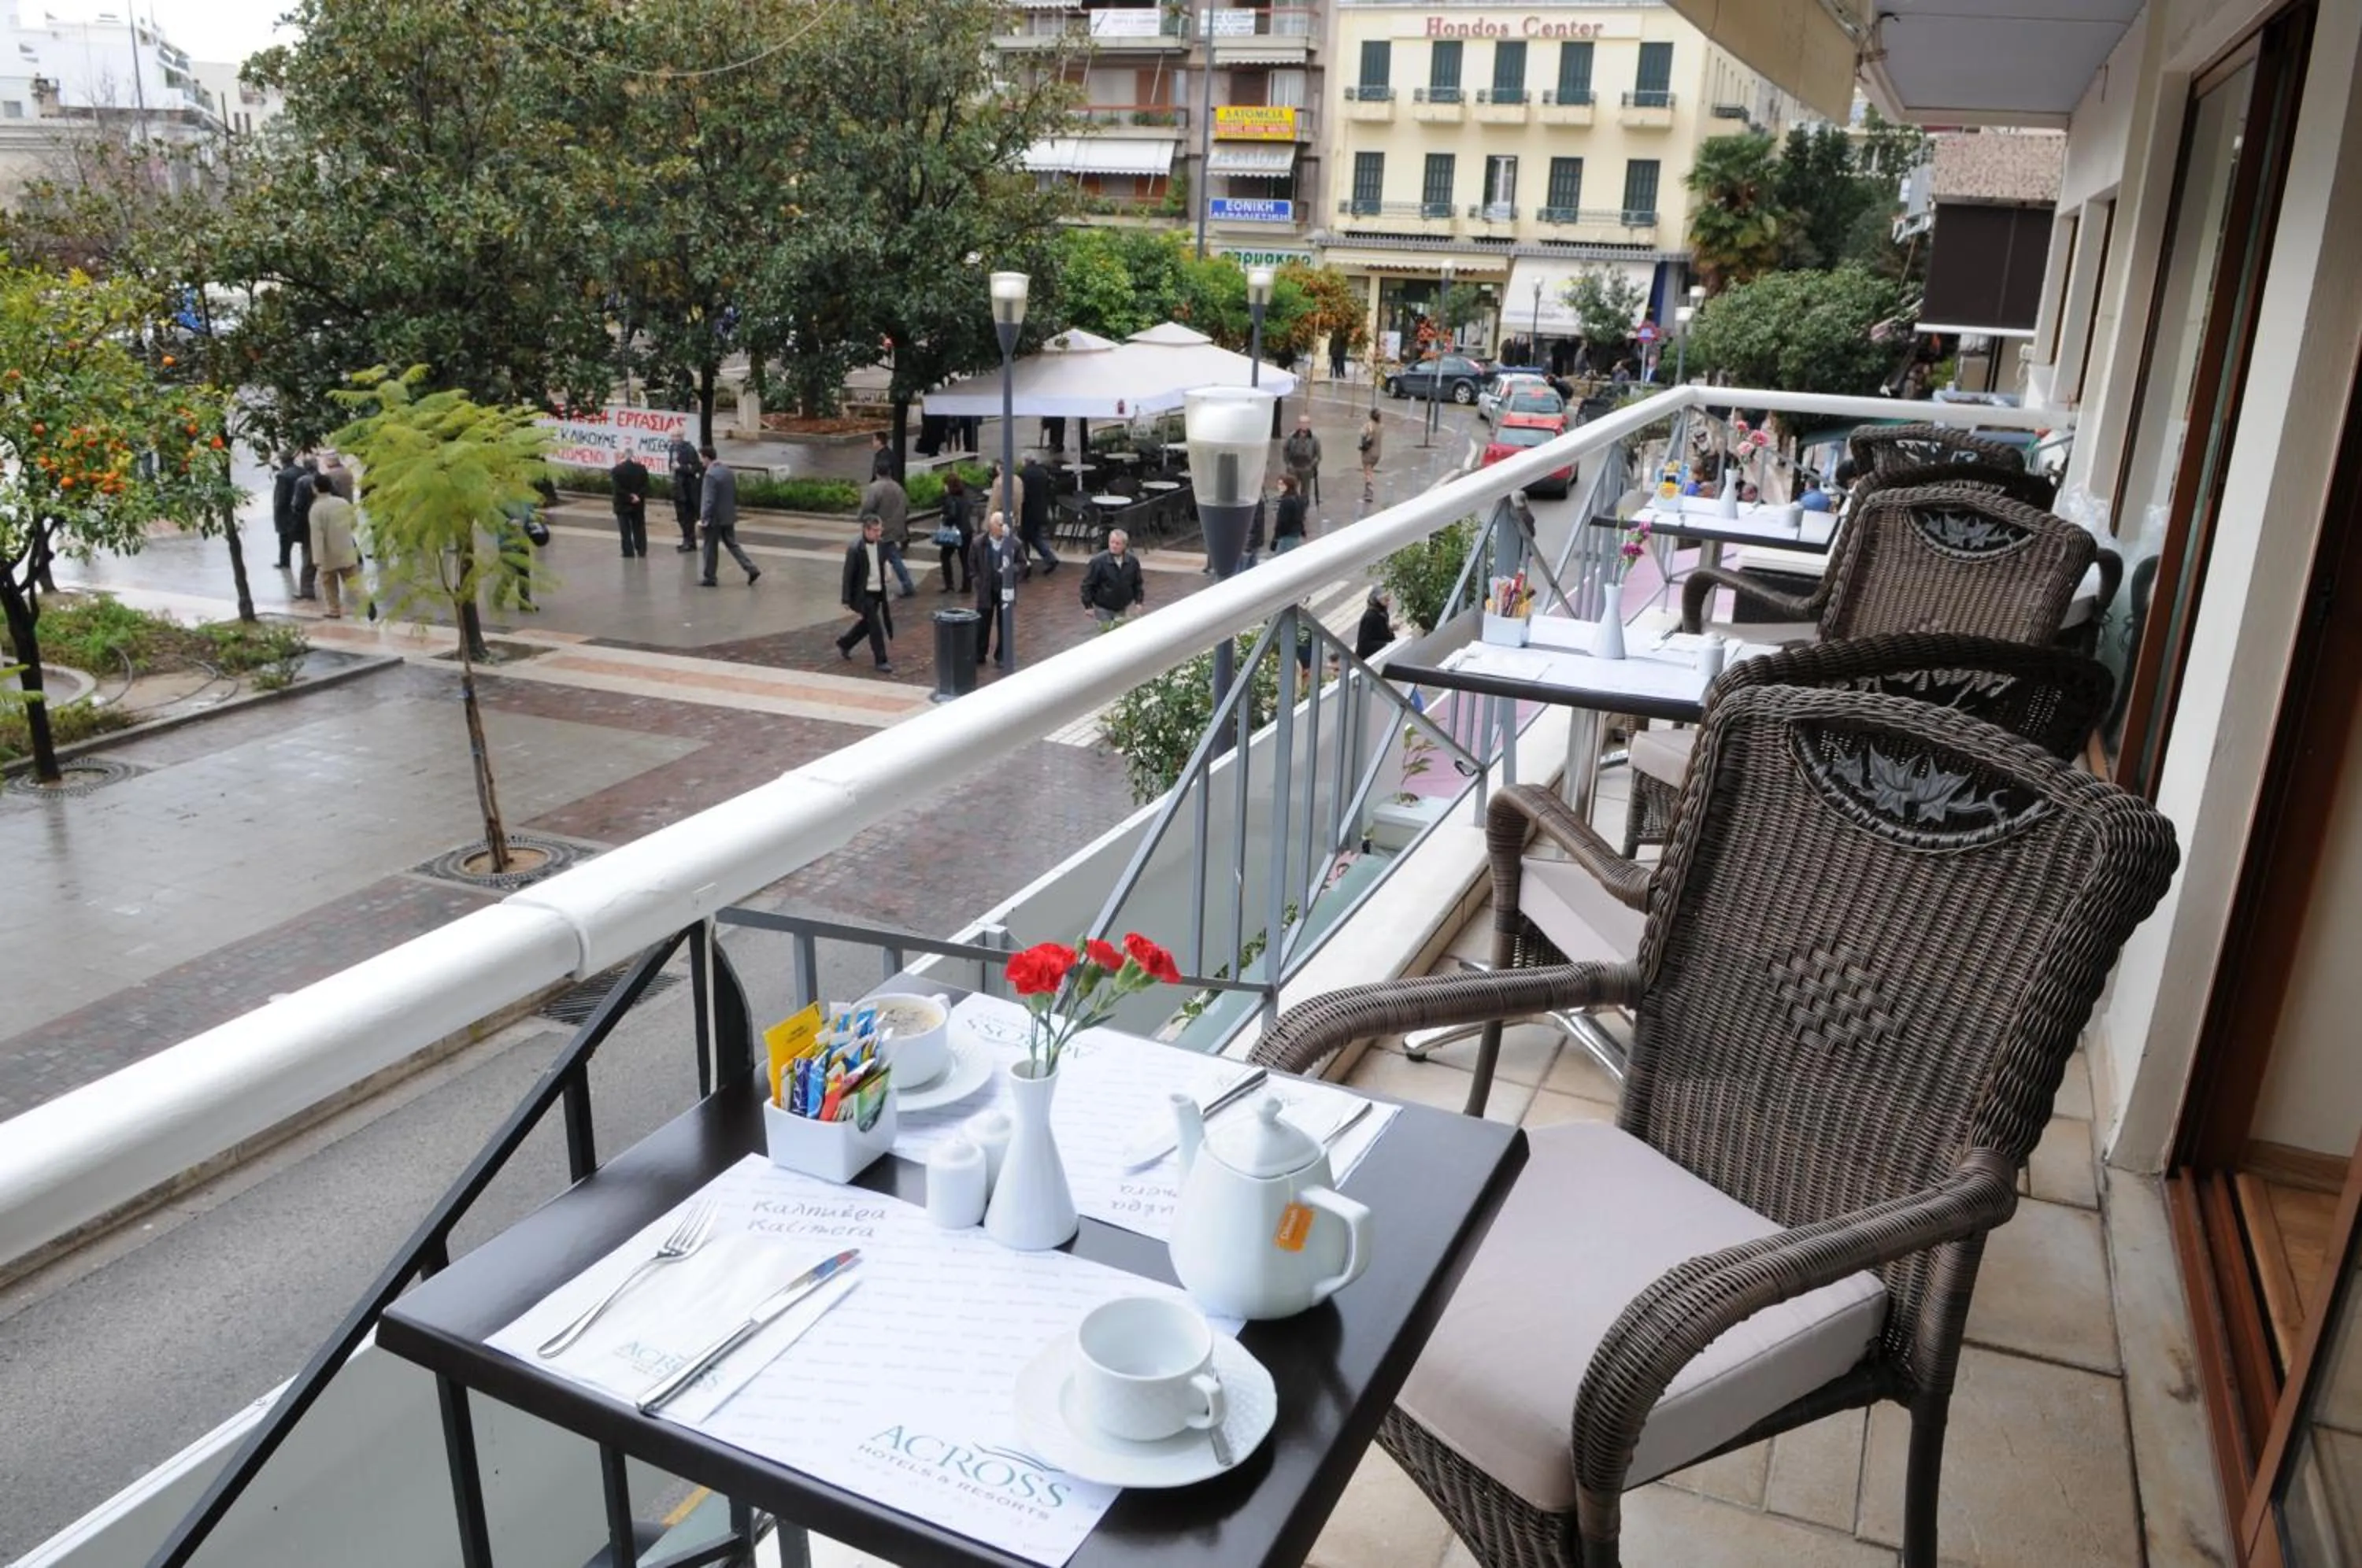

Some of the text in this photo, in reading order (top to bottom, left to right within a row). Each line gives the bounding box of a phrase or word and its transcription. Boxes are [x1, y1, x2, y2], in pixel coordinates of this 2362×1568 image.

[1426, 16, 1603, 38] Hondos Center
[616, 410, 686, 432] ΕΡΓΑΣΙΑΣ
[747, 1218, 877, 1239] Kalimera
[870, 1425, 1072, 1508] ACROSS
[857, 1444, 933, 1477] HOTELS
[957, 1481, 1050, 1521] RESORTS
